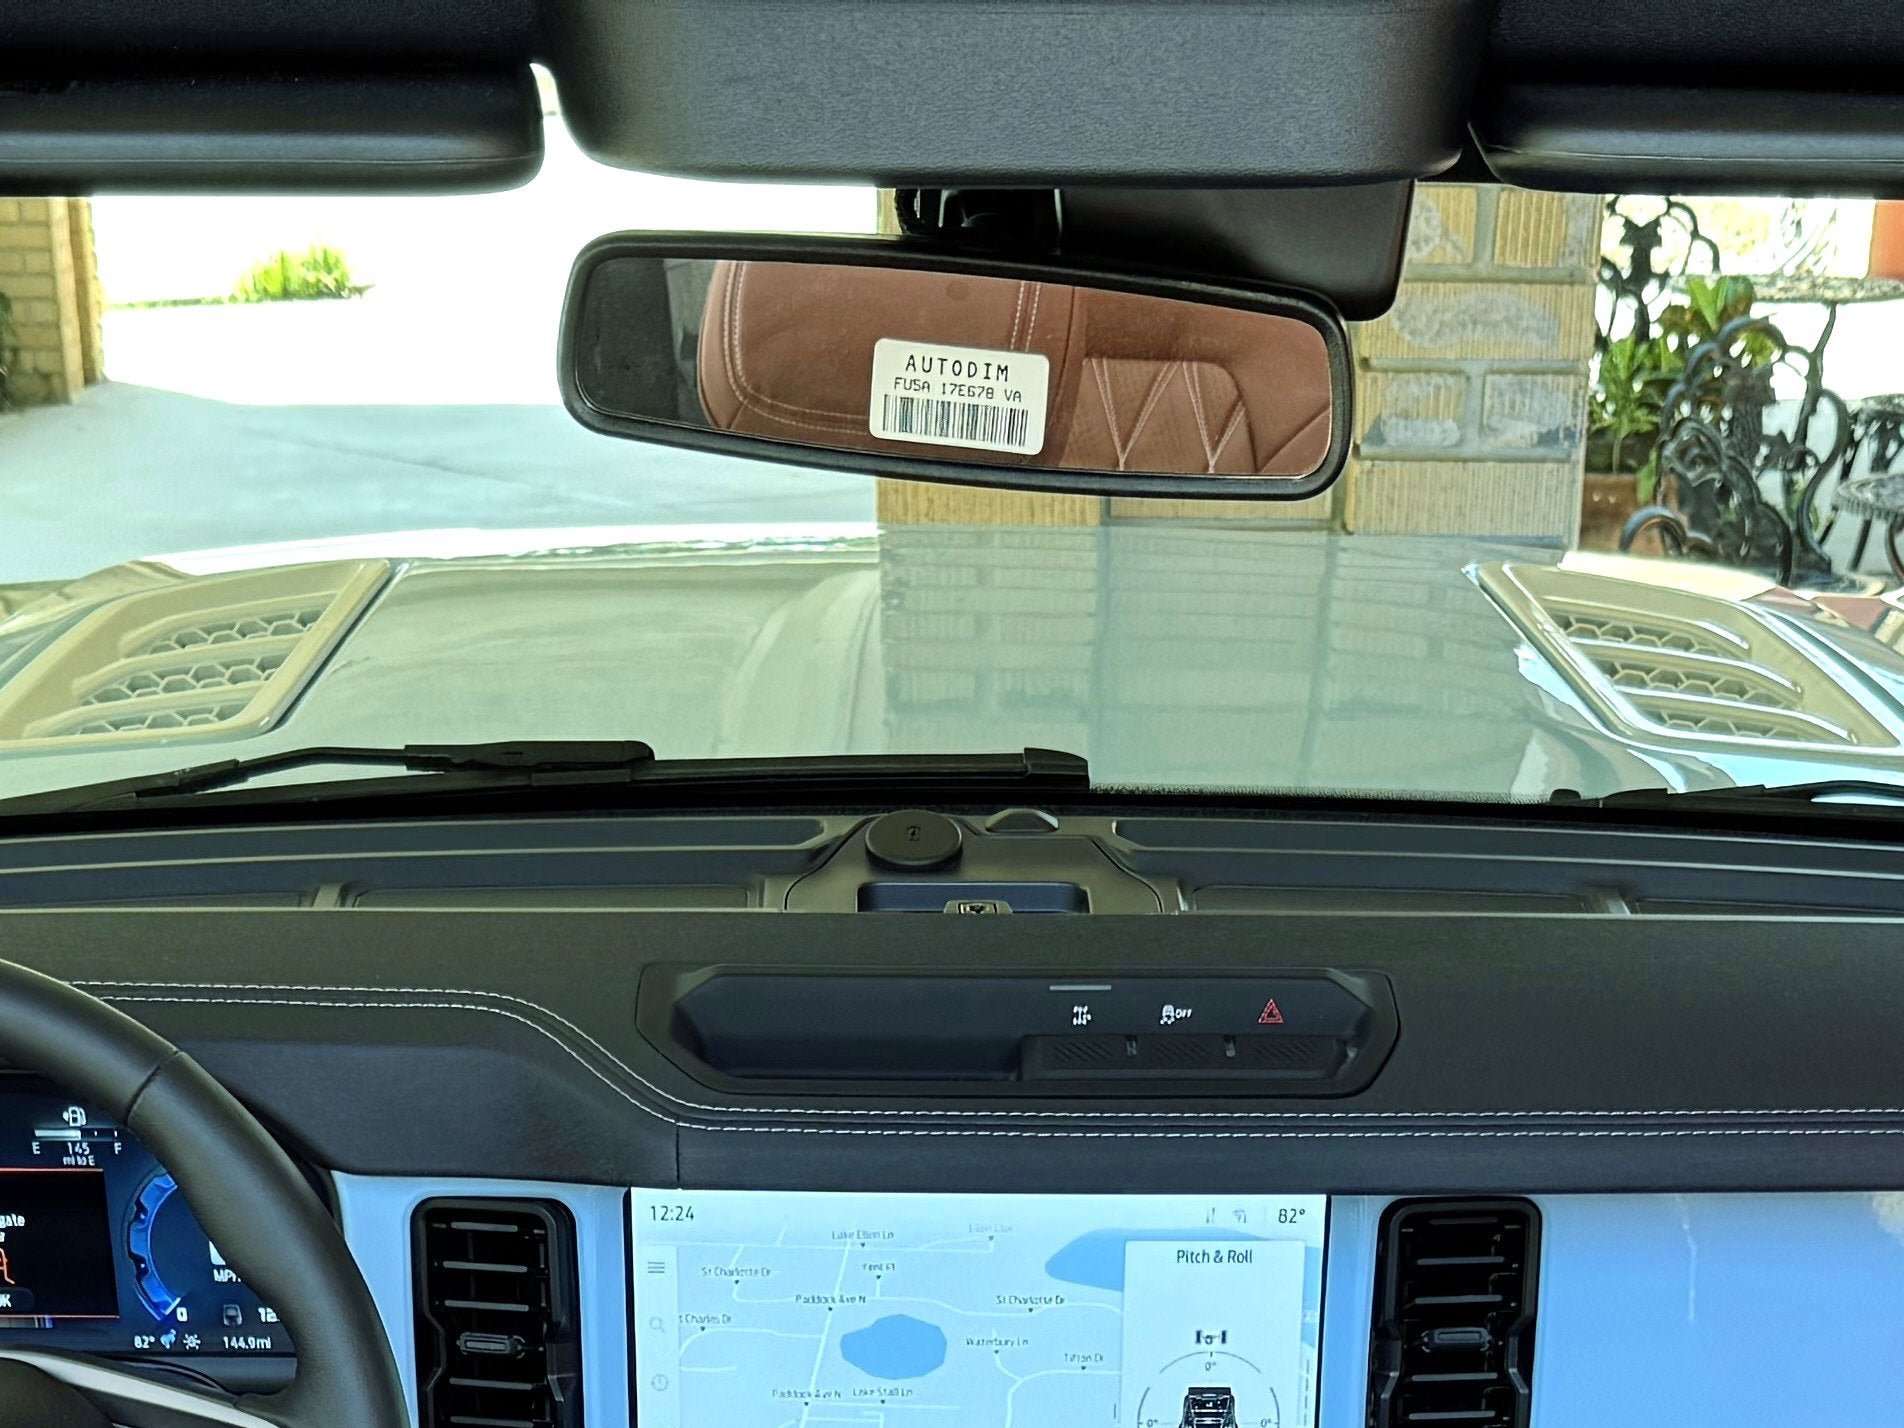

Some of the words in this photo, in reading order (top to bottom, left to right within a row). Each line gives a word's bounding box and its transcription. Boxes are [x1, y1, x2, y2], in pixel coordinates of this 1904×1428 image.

[905, 354, 1009, 382] AUTODIM
[894, 376, 931, 393] FU5A
[942, 382, 995, 400] 17E678
[1004, 389, 1022, 402] VA
[32, 1141, 41, 1155] E
[67, 1142, 90, 1155] 145
[113, 1142, 122, 1155] F
[649, 1204, 695, 1222] 12:24
[1277, 1208, 1306, 1225] 82°
[1176, 1249, 1210, 1265] Pitch
[1213, 1249, 1224, 1265] &
[1227, 1249, 1253, 1265] Roll
[175, 1306, 189, 1322] 0
